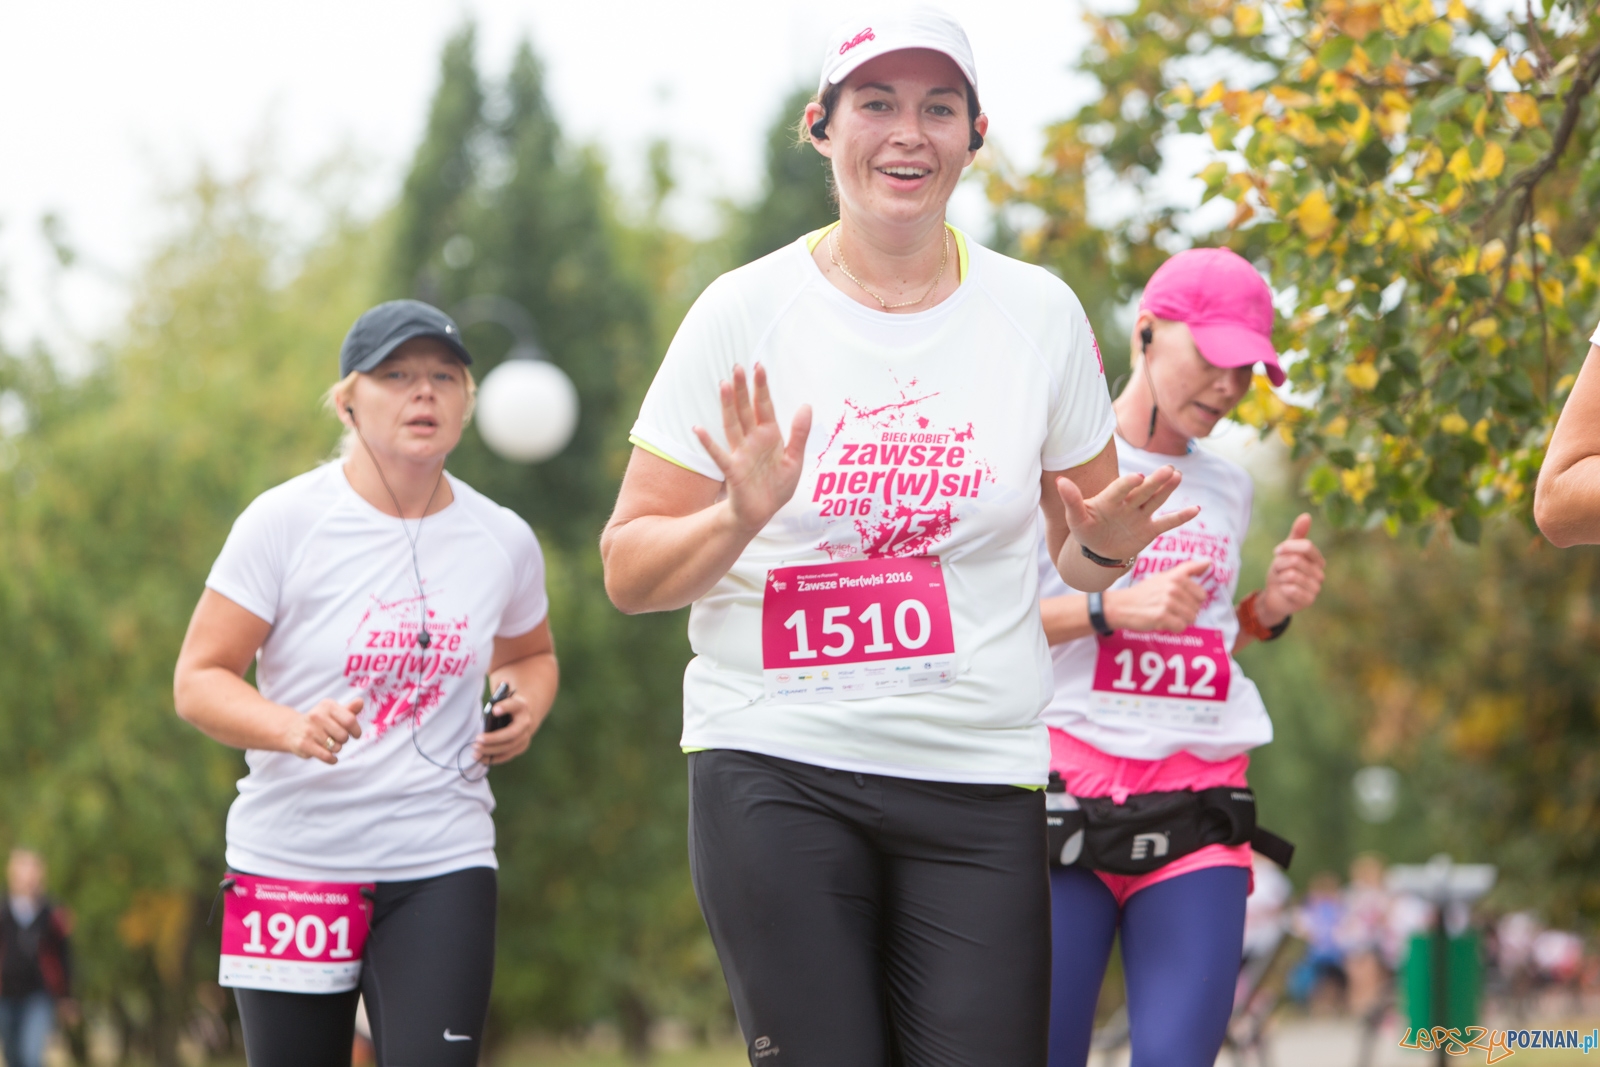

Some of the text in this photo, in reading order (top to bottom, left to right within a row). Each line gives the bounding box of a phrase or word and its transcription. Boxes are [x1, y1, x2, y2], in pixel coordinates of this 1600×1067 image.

[881, 432, 950, 444] BIEG KOBIET
[838, 443, 965, 468] zawsze
[819, 498, 872, 517] 2016
[797, 580, 838, 592] Zawsze
[839, 572, 884, 590] Pier(w)si
[885, 571, 913, 584] 2016
[783, 598, 931, 660] 1510
[1112, 649, 1217, 697] 1912
[242, 911, 353, 958] 1901
